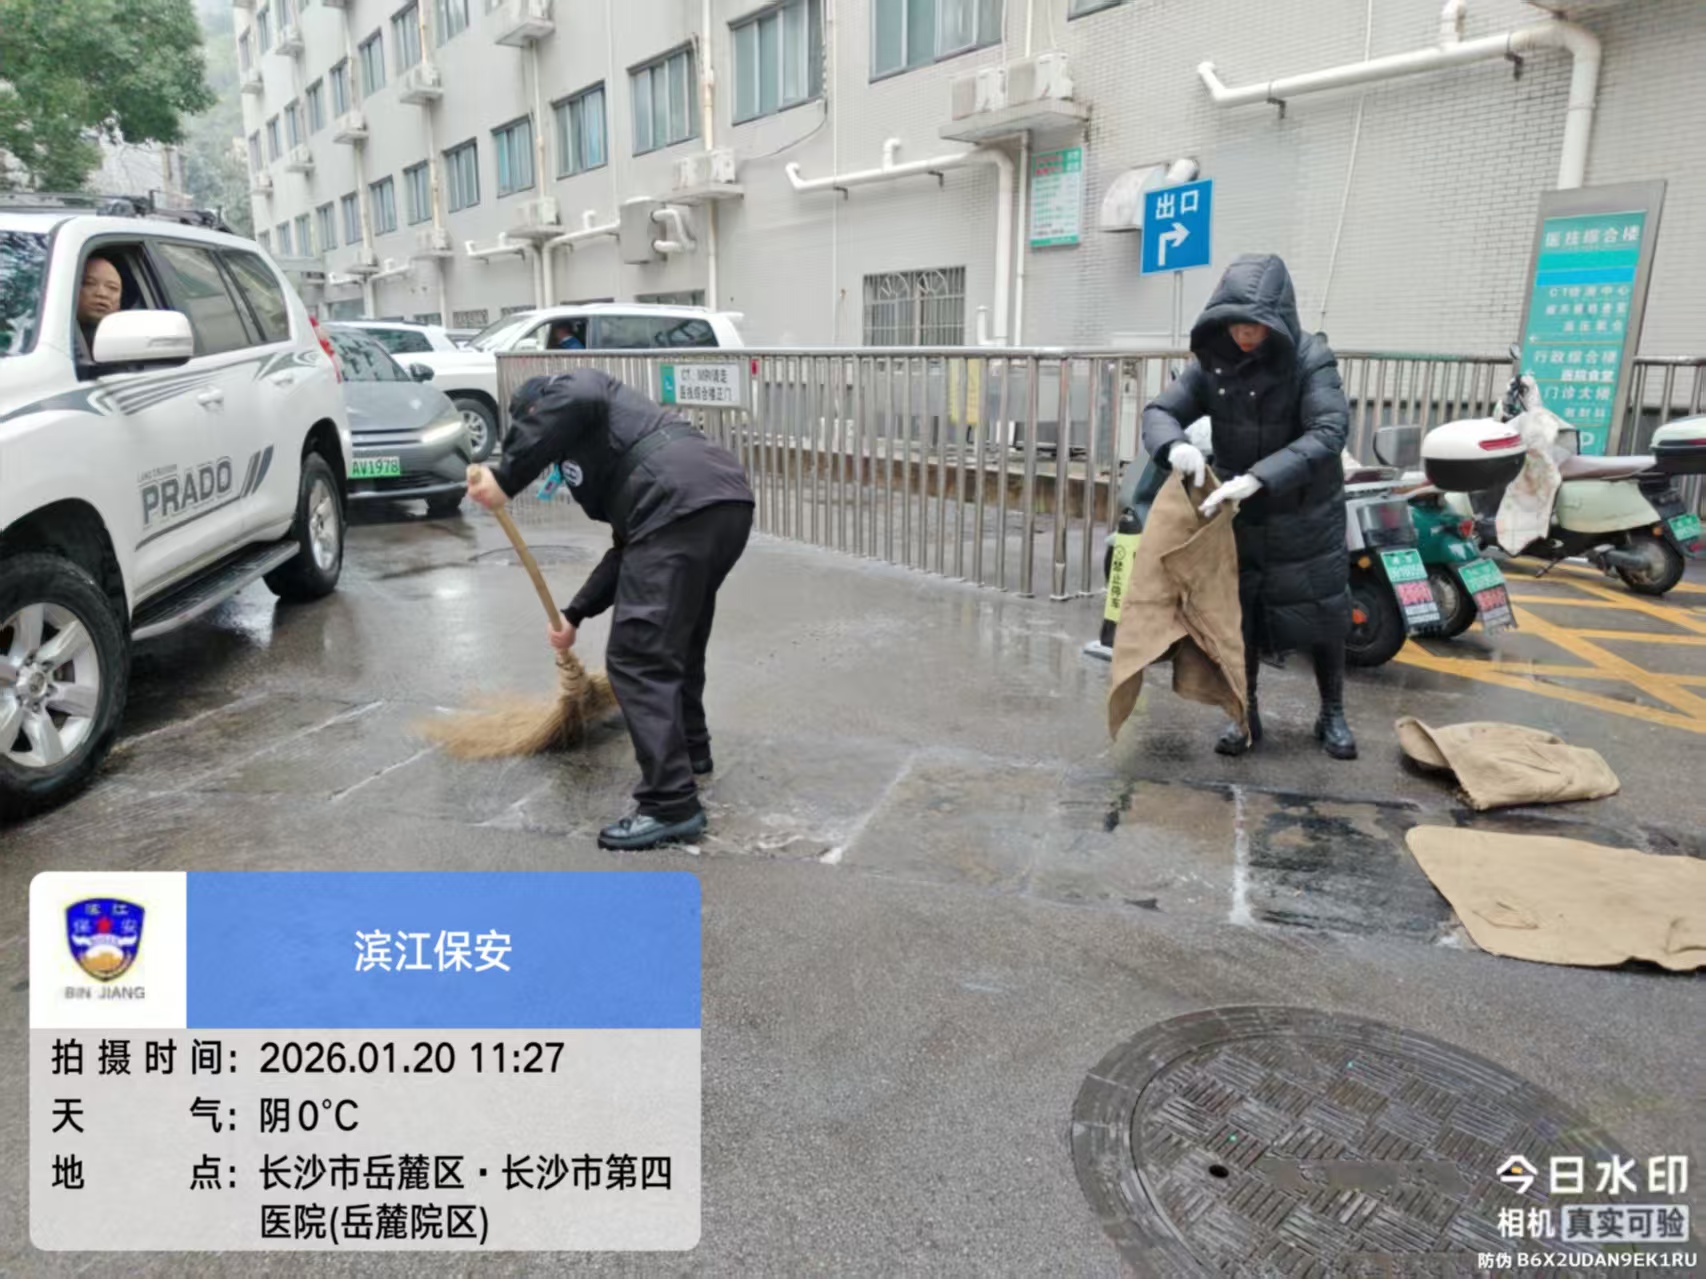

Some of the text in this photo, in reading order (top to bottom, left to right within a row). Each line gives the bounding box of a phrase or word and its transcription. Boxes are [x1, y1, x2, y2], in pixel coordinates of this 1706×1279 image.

[1155, 190, 1199, 219] 出口
[352, 459, 399, 475] AV1978
[142, 460, 231, 525] PRADO
